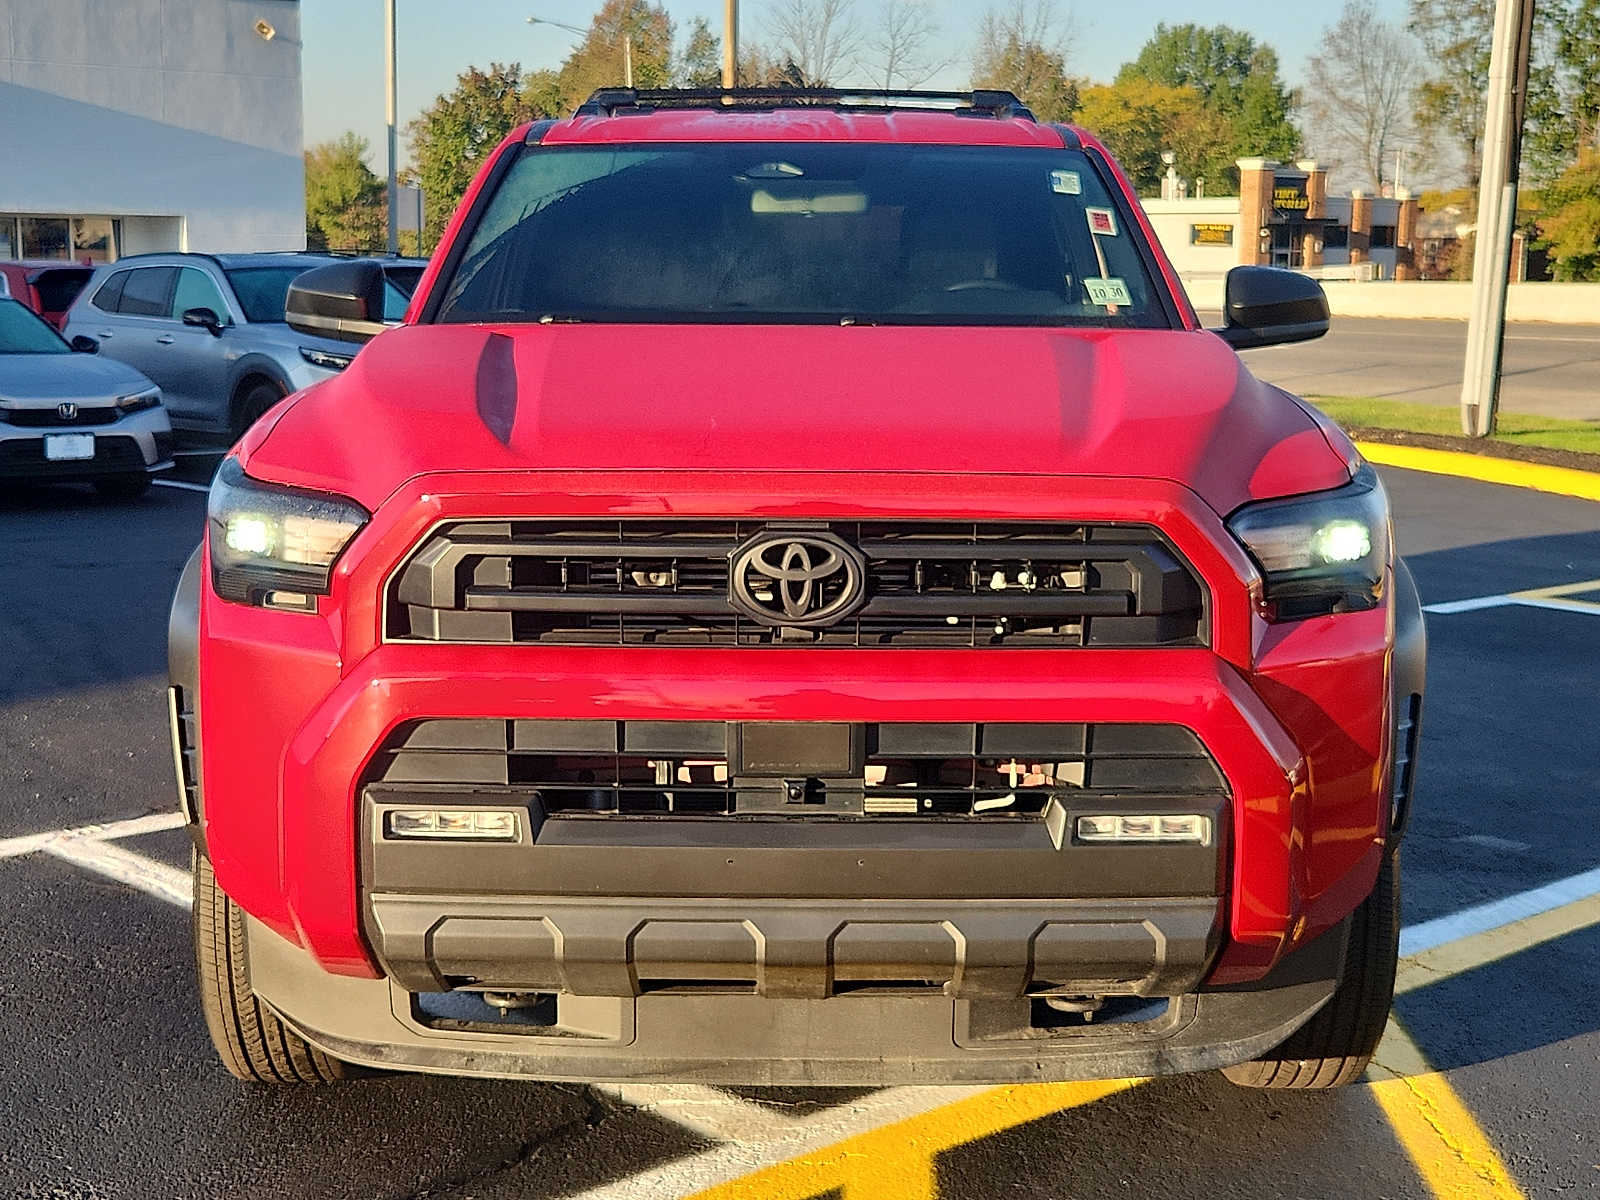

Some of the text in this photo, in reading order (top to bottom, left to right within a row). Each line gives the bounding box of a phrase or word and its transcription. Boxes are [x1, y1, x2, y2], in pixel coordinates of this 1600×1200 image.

[1274, 199, 1308, 209] WORLD
[1092, 287, 1124, 298] 10 30
